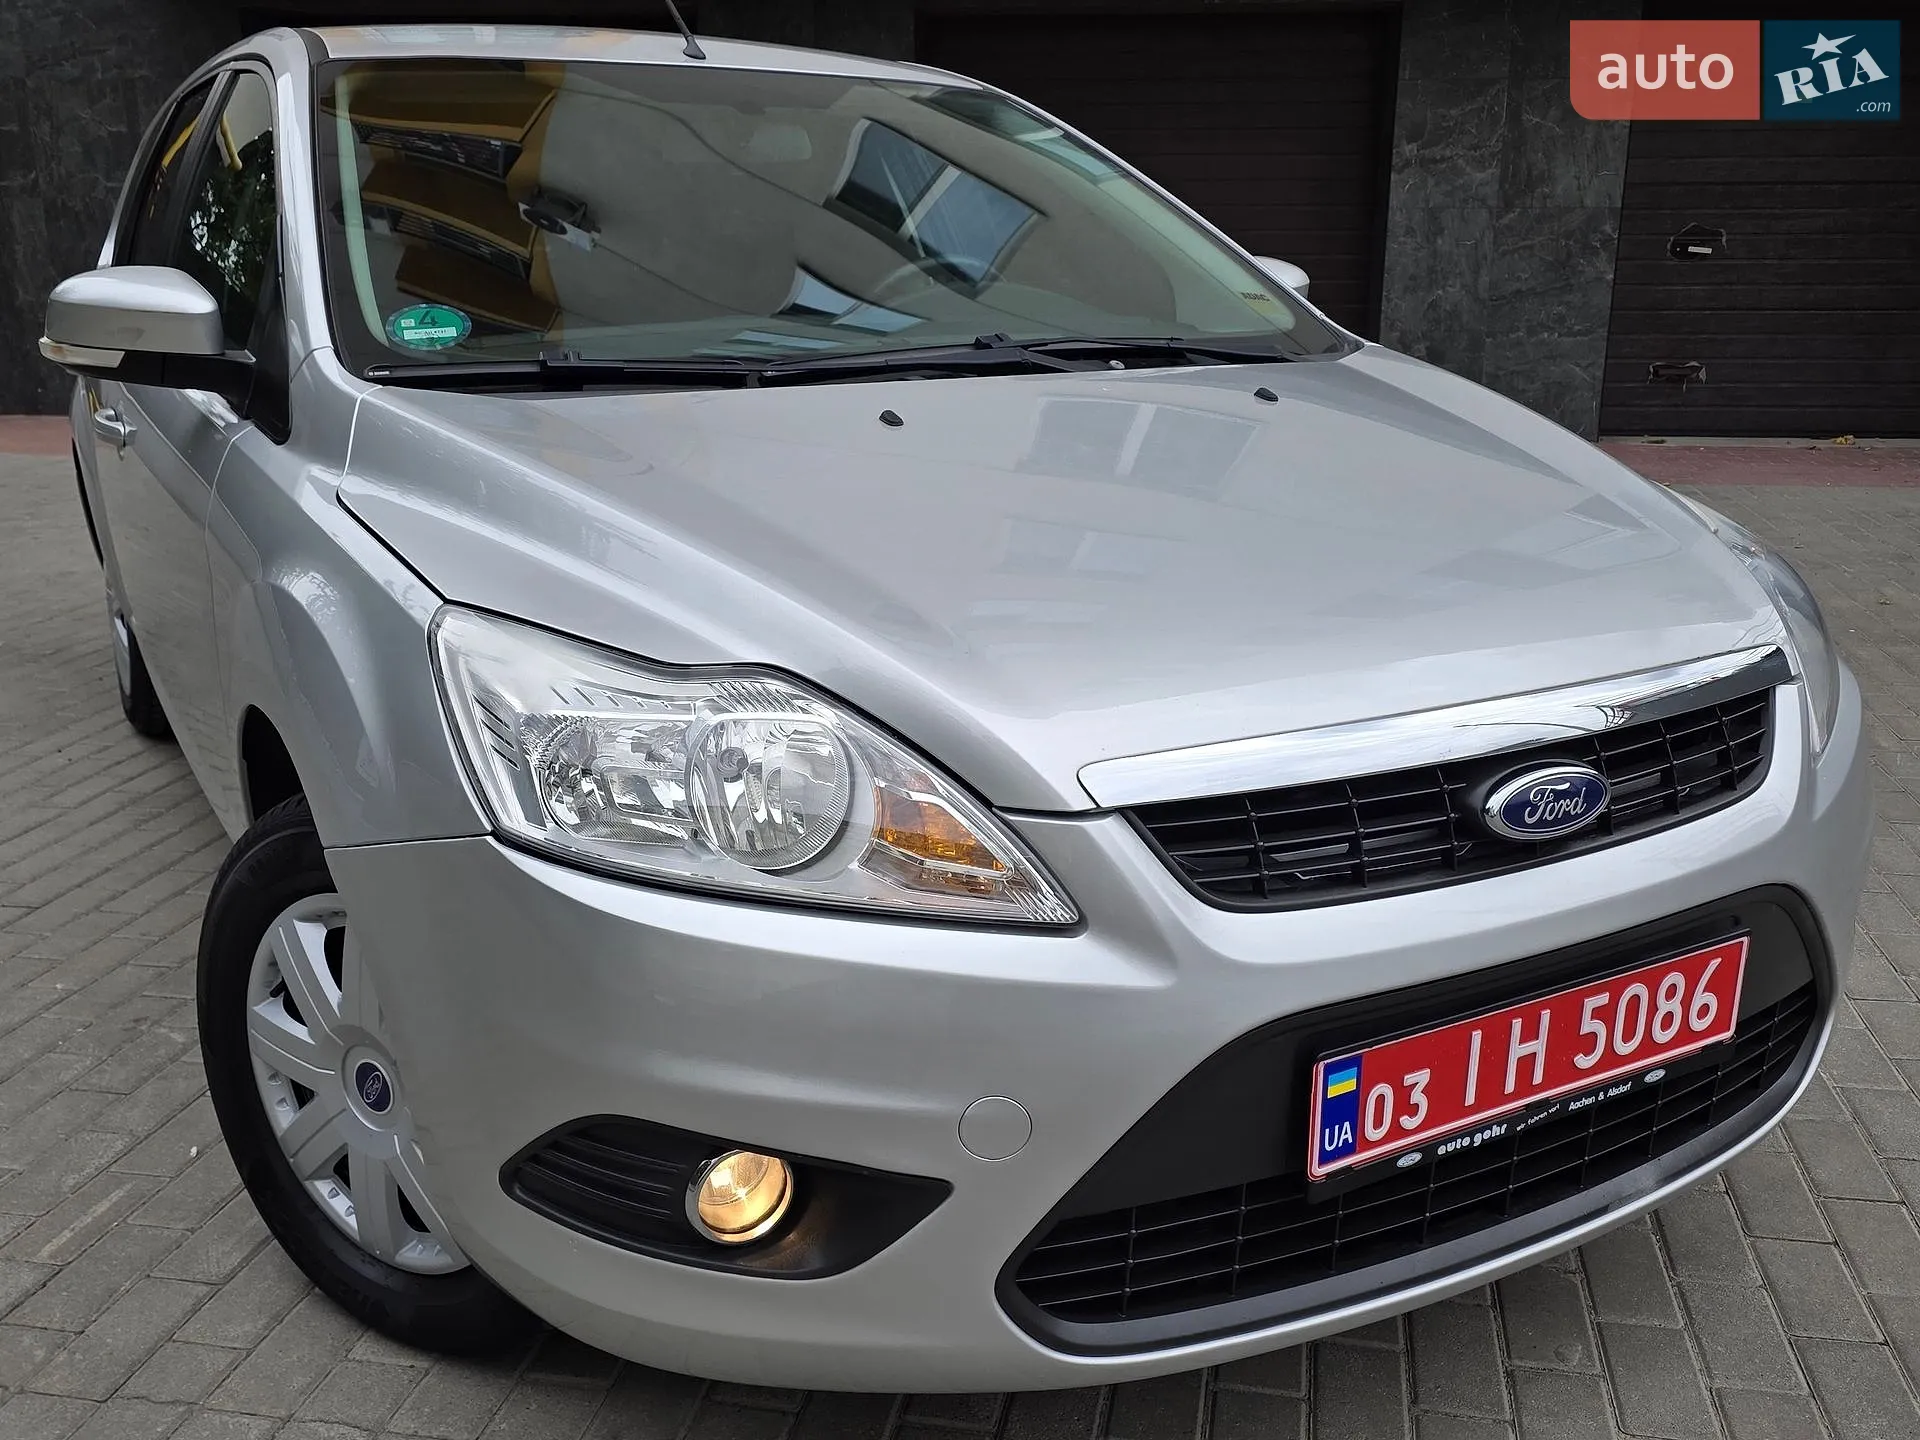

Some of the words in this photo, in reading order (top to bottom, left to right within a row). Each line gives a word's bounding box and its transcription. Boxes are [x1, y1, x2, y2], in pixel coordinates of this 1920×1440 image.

[418, 309, 438, 326] 4
[1524, 782, 1587, 824] Ford
[1363, 1068, 1431, 1142] 03
[1573, 957, 1722, 1070] 5086
[1568, 1096, 1595, 1111] Aachen
[1597, 1091, 1605, 1101] &
[1607, 1081, 1632, 1098] Alsdorf
[1324, 1120, 1353, 1152] UA
[1437, 1136, 1471, 1155] auto
[1473, 1123, 1508, 1147] gohr
